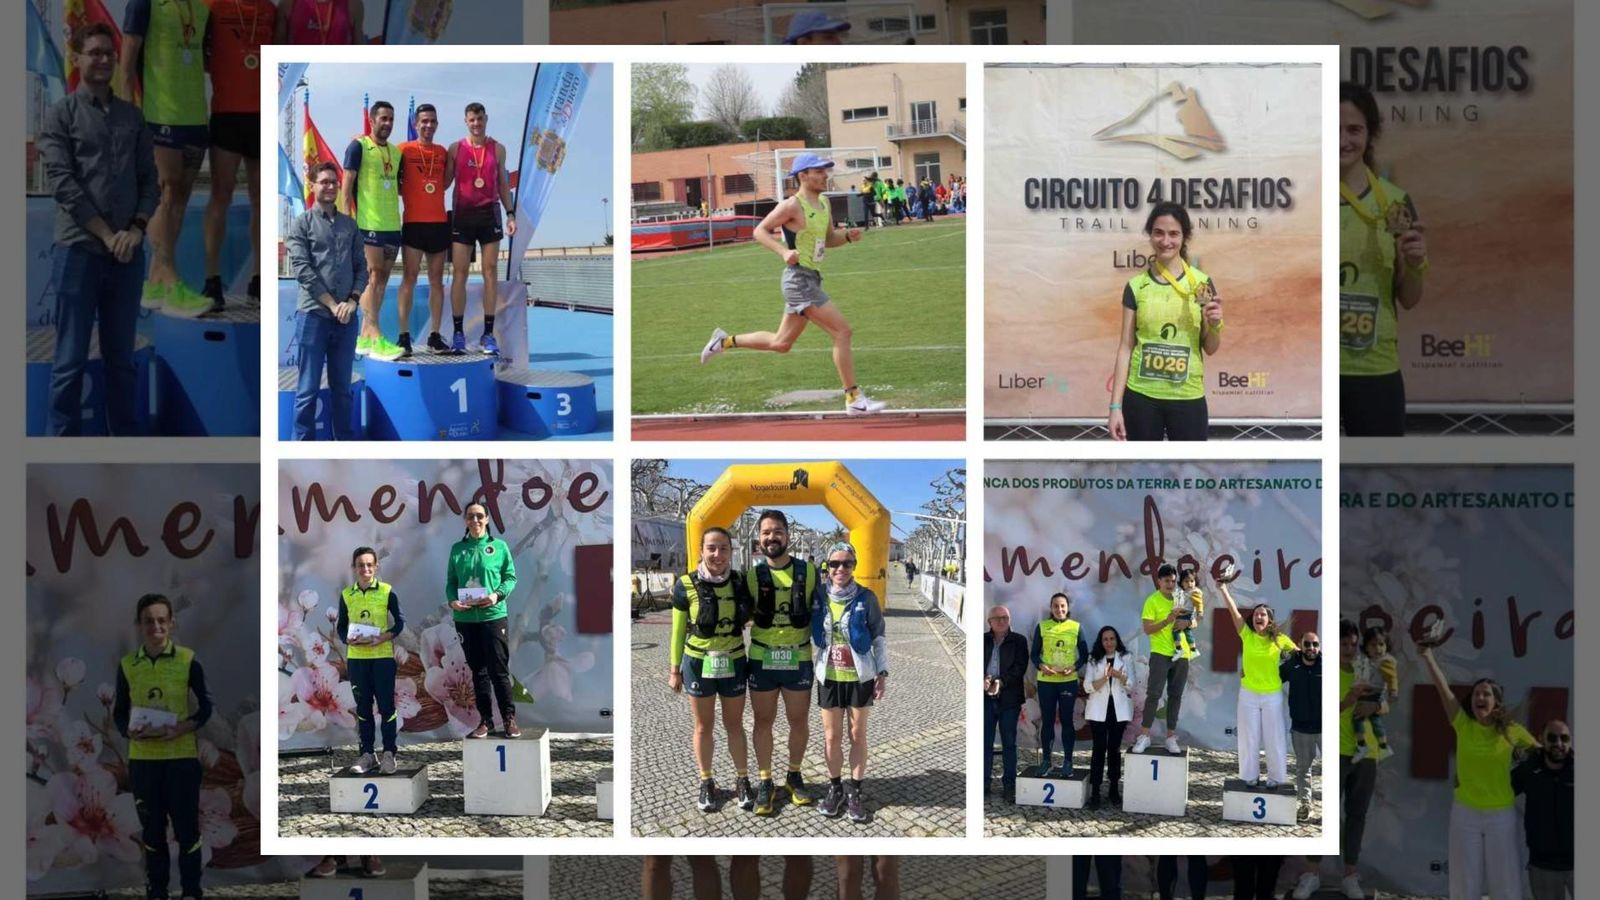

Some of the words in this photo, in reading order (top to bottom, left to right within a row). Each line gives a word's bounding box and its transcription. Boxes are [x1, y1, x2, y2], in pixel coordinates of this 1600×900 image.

[1350, 46, 1530, 92] DESAFIOS
[1391, 105, 1480, 122] NING
[1025, 177, 1140, 209] CIRCUITO
[1147, 178, 1164, 206] 4
[1171, 177, 1293, 209] DESAFIOS
[1060, 217, 1129, 230] TRAIL
[1198, 217, 1260, 230] NING
[1143, 353, 1188, 372] 1026
[450, 377, 468, 414] 1
[556, 393, 572, 416] 3
[1013, 477, 1040, 489] DOS
[1043, 477, 1114, 490] PRODUTOS
[1117, 478, 1135, 490] DA
[1137, 478, 1181, 490] TERRA
[1184, 478, 1193, 490] E
[1196, 478, 1216, 490] DO
[1219, 478, 1312, 490] ARTESANATO
[278, 459, 609, 535] mendoe
[1369, 492, 1382, 509] E
[1387, 492, 1417, 509] DO
[1421, 492, 1560, 509] ARTESANATO
[710, 658, 729, 667] 1031
[771, 650, 792, 660] 1030
[495, 745, 506, 772] 1
[1150, 759, 1159, 781] 1
[363, 783, 379, 810] 2
[1043, 783, 1055, 804] 2
[1253, 797, 1267, 820] 3
